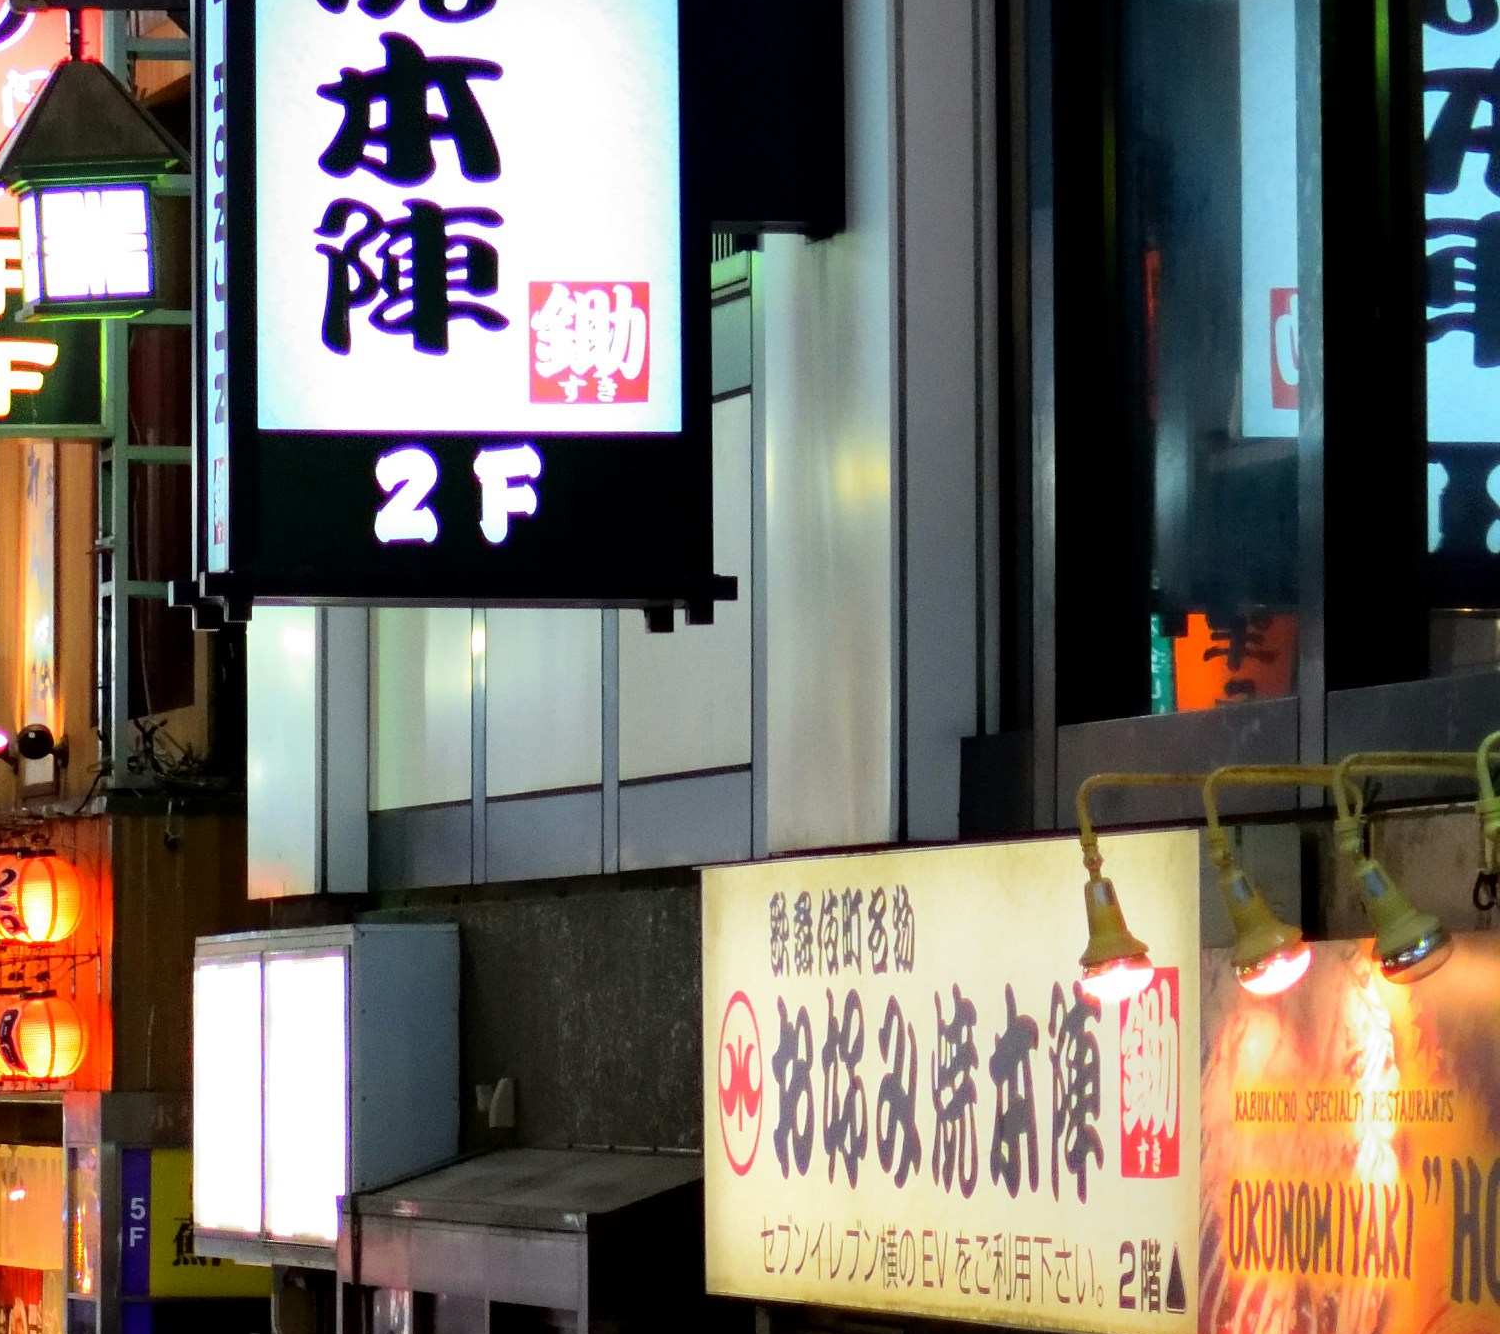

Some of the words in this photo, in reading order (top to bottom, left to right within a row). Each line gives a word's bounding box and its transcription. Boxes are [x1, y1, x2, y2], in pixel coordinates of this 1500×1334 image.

[556, 373, 617, 404] すき
[373, 444, 544, 545] 2F
[771, 980, 1106, 1204] お好み焼本陣
[1234, 1088, 1298, 1122] KABUKICHO
[1135, 1142, 1162, 1176] すき
[128, 1197, 147, 1248] 5F
[1228, 1177, 1416, 1279] OKONOMIYAKI
[1118, 1240, 1162, 1313] 2階
